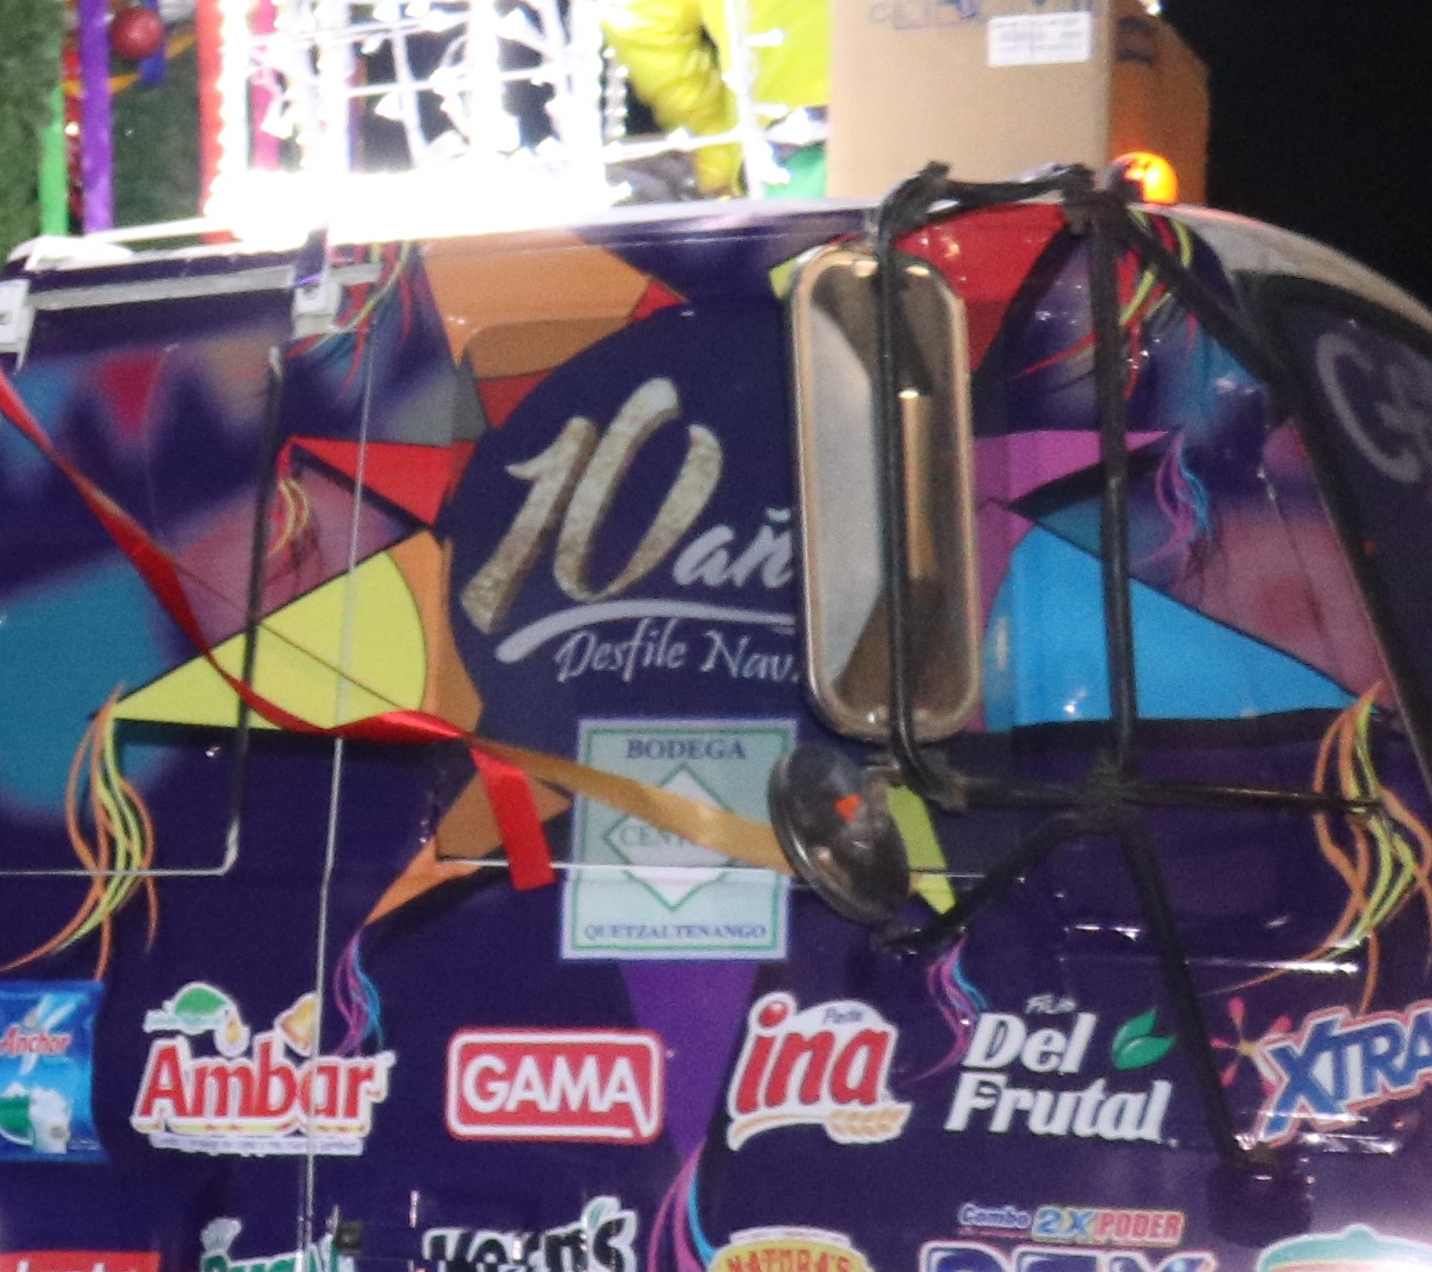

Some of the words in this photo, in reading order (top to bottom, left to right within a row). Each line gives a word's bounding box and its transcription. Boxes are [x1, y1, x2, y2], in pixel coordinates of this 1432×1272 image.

[460, 376, 725, 634] 10
[554, 616, 689, 683] Desfile
[626, 738, 747, 762] BODEGA
[584, 923, 768, 942] QUETZALTENANGO
[735, 1000, 890, 1115] ina
[962, 1011, 1099, 1075] Del
[137, 1039, 376, 1120] Ambar
[462, 1053, 653, 1117] GAMA
[944, 1071, 1173, 1143] Frutal
[959, 1202, 1032, 1229] Combo
[1095, 1209, 1185, 1241] PODER
